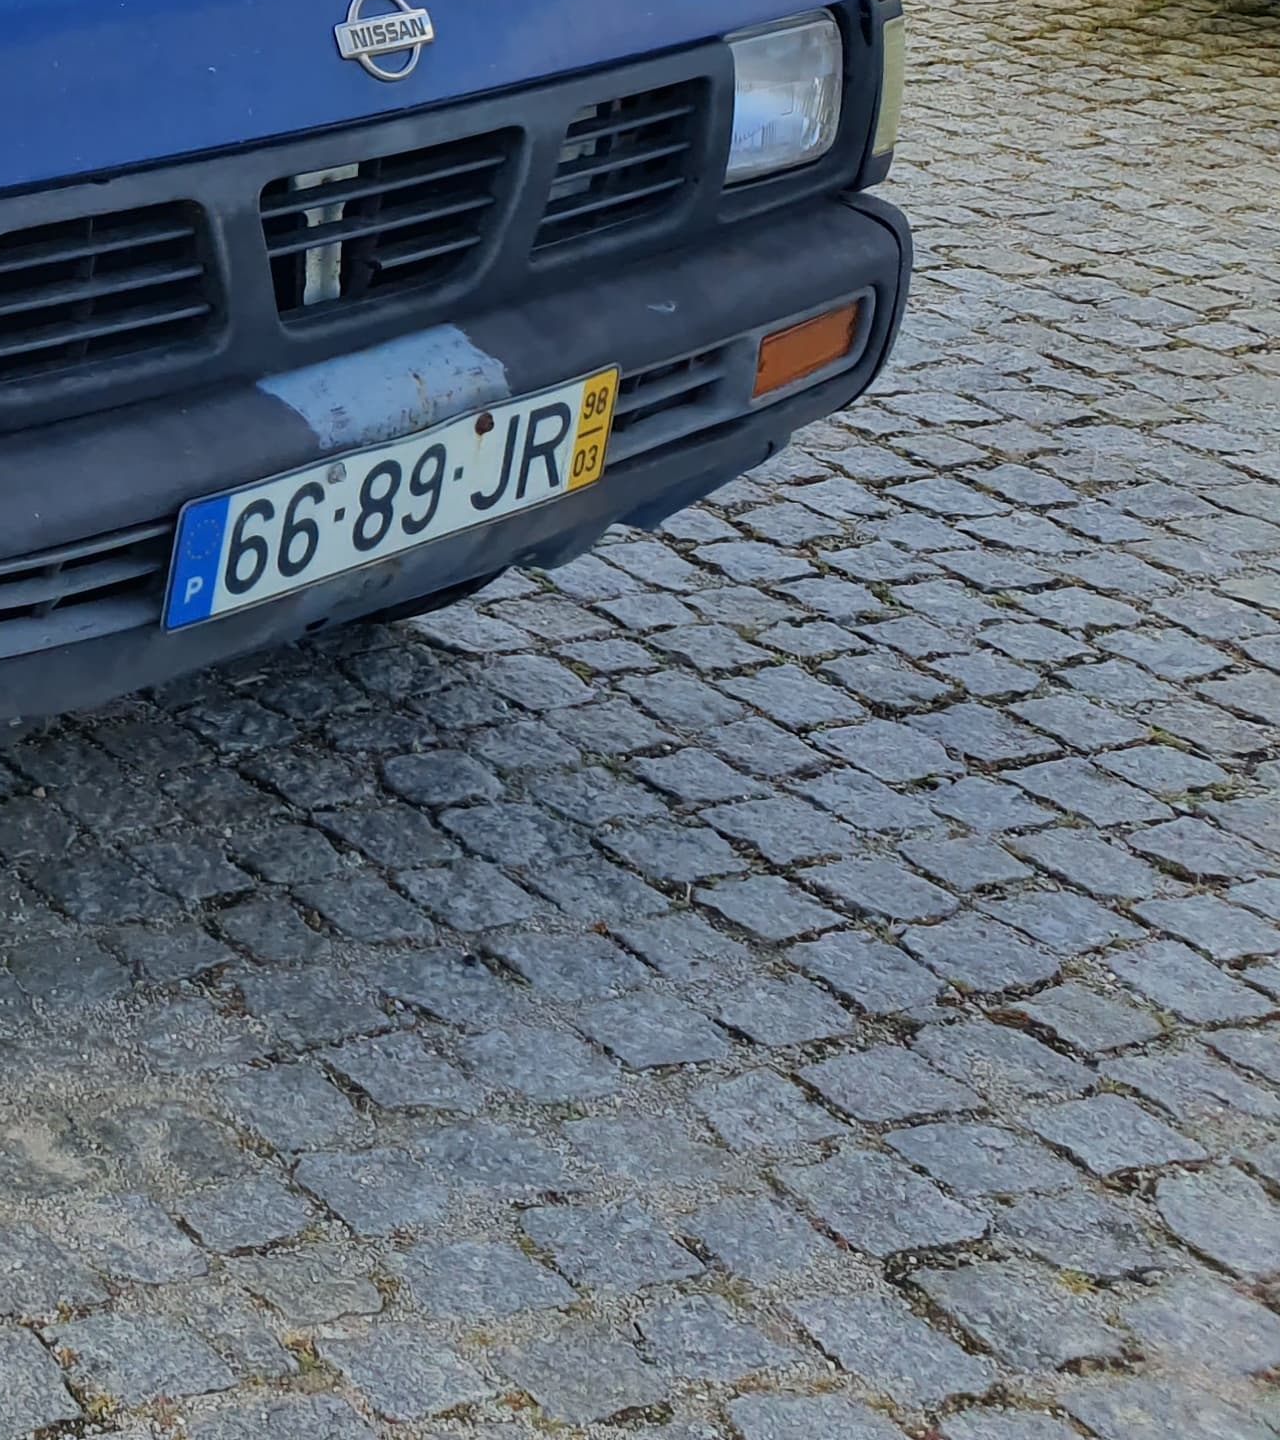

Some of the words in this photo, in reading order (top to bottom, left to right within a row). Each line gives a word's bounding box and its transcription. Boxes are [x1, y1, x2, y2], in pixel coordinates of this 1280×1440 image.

[350, 16, 427, 49] NISSAN
[582, 386, 608, 420] 98
[572, 444, 598, 477] 03
[183, 575, 203, 604] P
